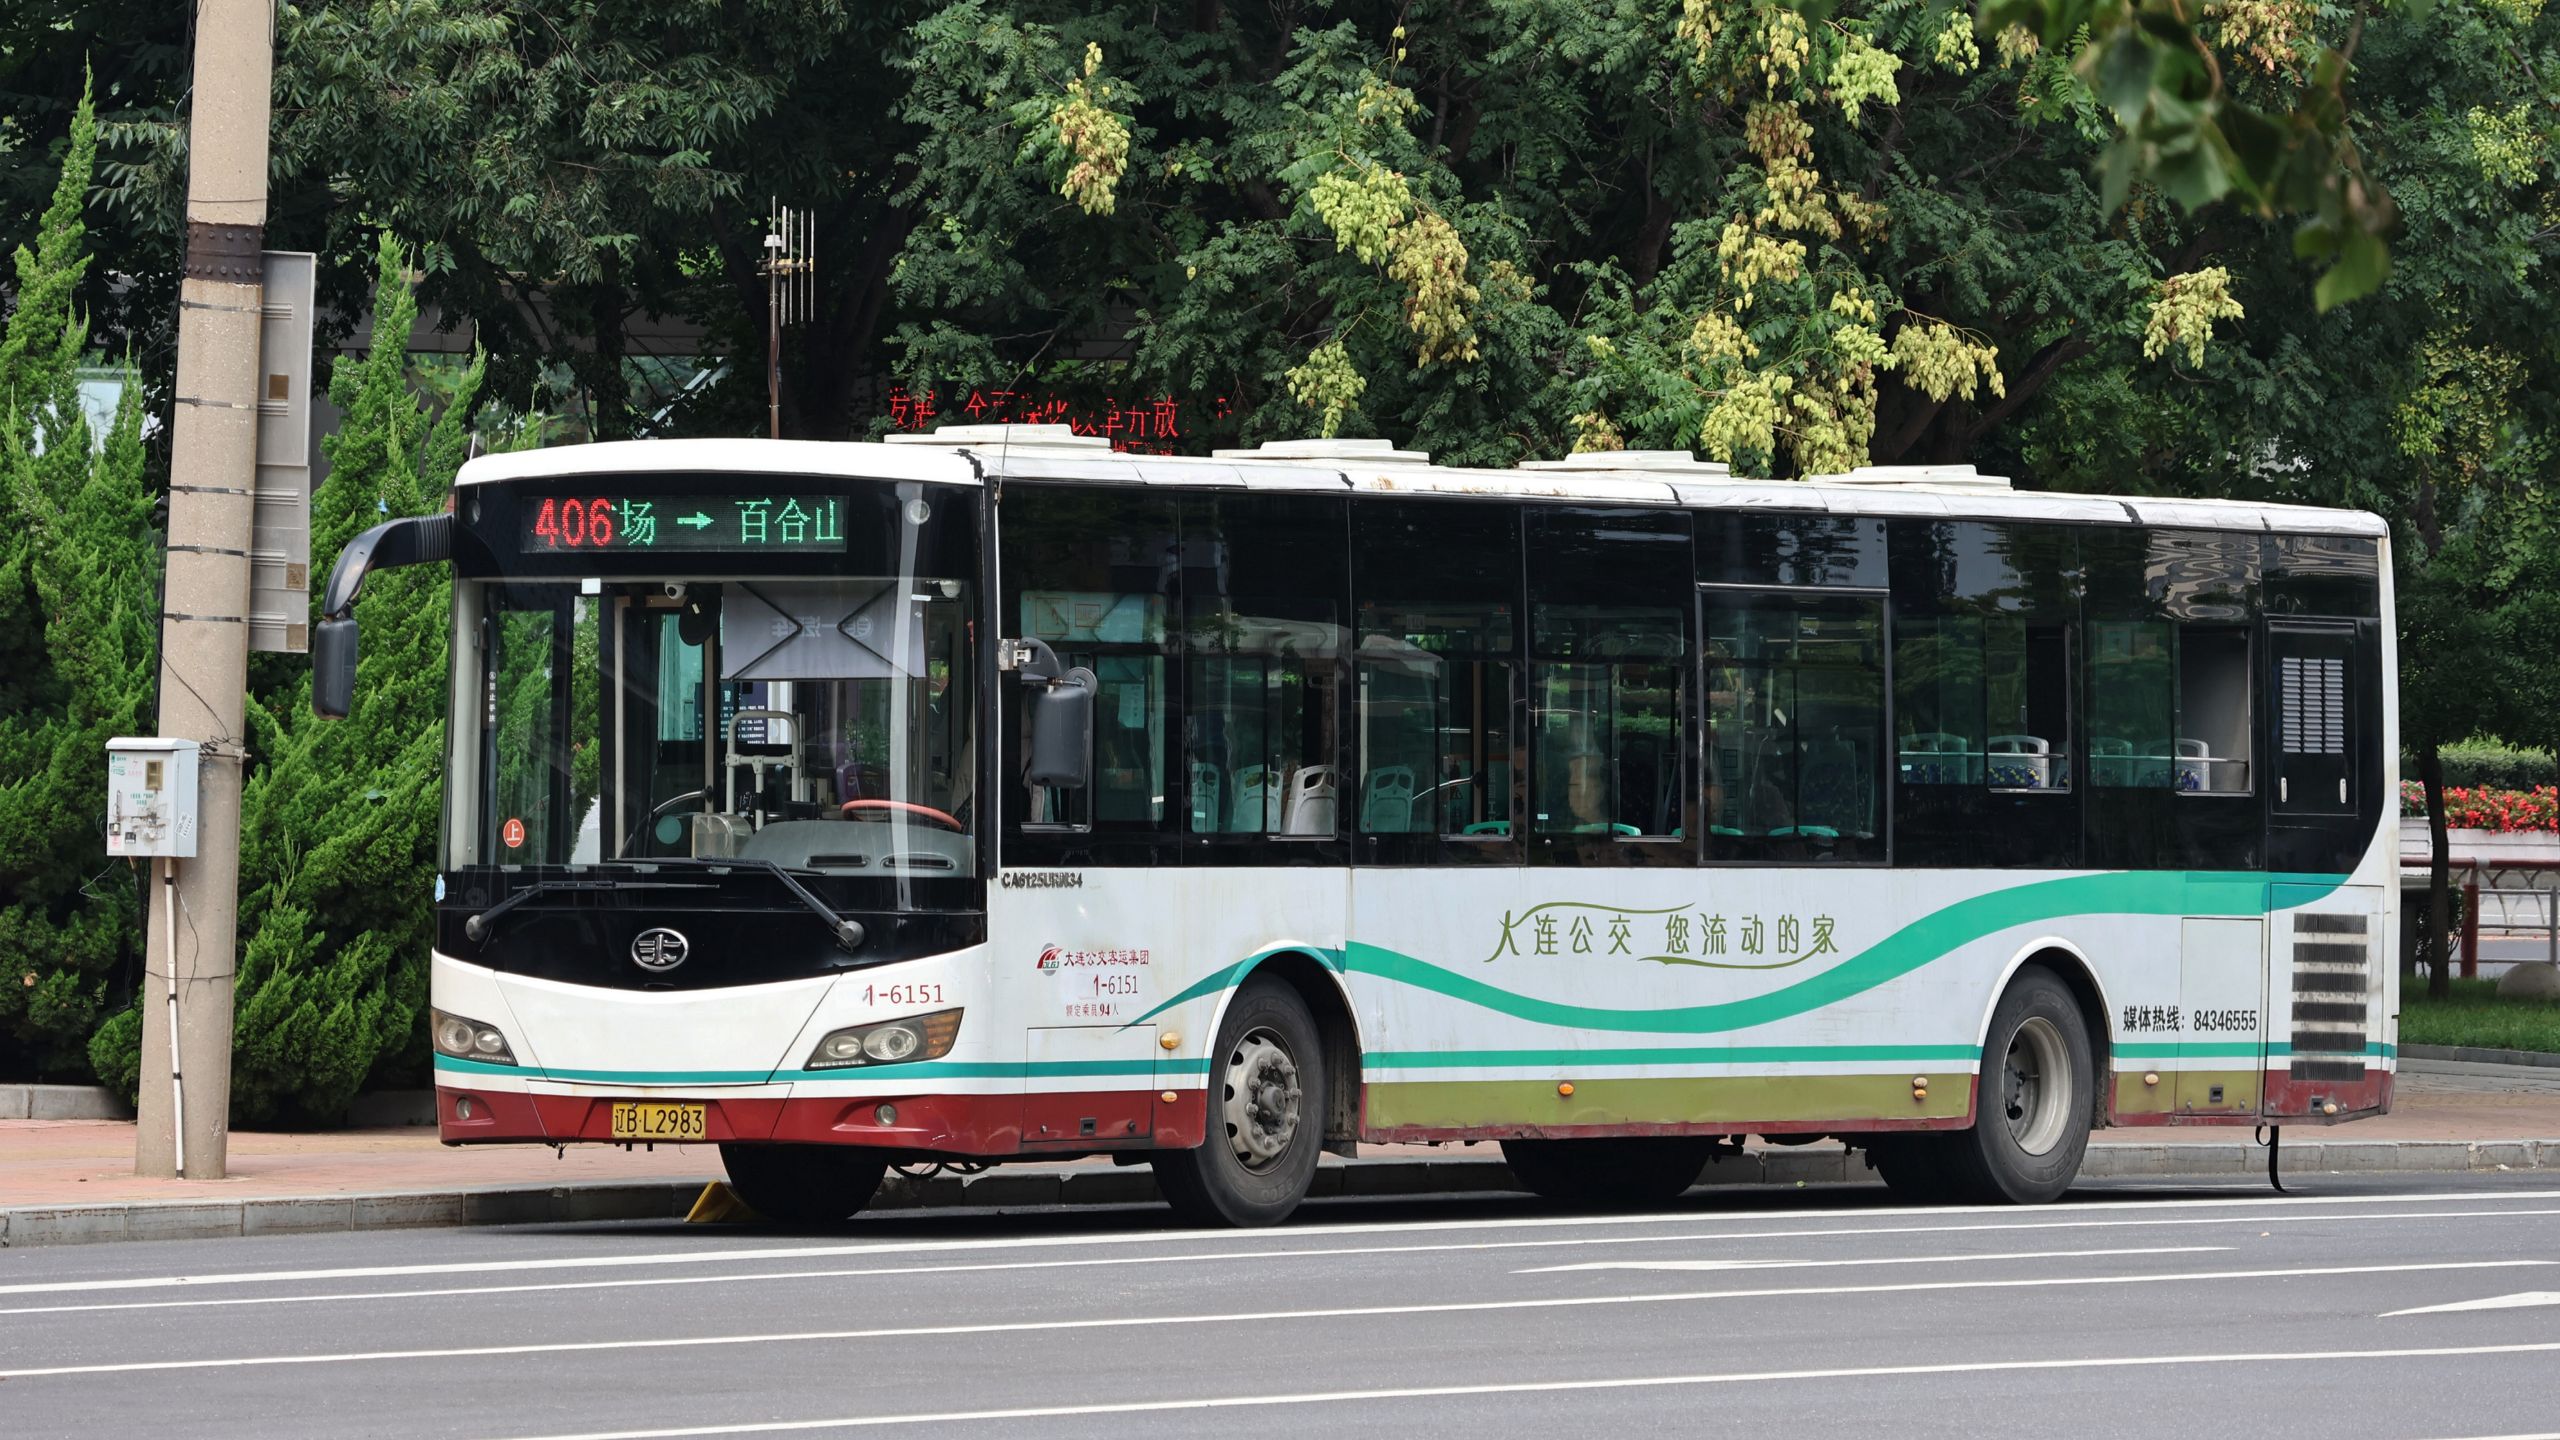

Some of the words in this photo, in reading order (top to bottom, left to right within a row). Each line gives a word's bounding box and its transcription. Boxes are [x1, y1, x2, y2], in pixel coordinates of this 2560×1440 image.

[535, 498, 613, 546] 406
[735, 497, 844, 544] 百合山
[506, 823, 521, 841] 上
[1484, 909, 1632, 963] 大连公交
[1665, 912, 1839, 956] 您流动的家
[1064, 950, 1149, 967] 大连公交客运集团
[865, 984, 945, 1006] 1-6151
[1093, 974, 1139, 996] 1-6151
[2193, 1009, 2257, 1031] 84346555
